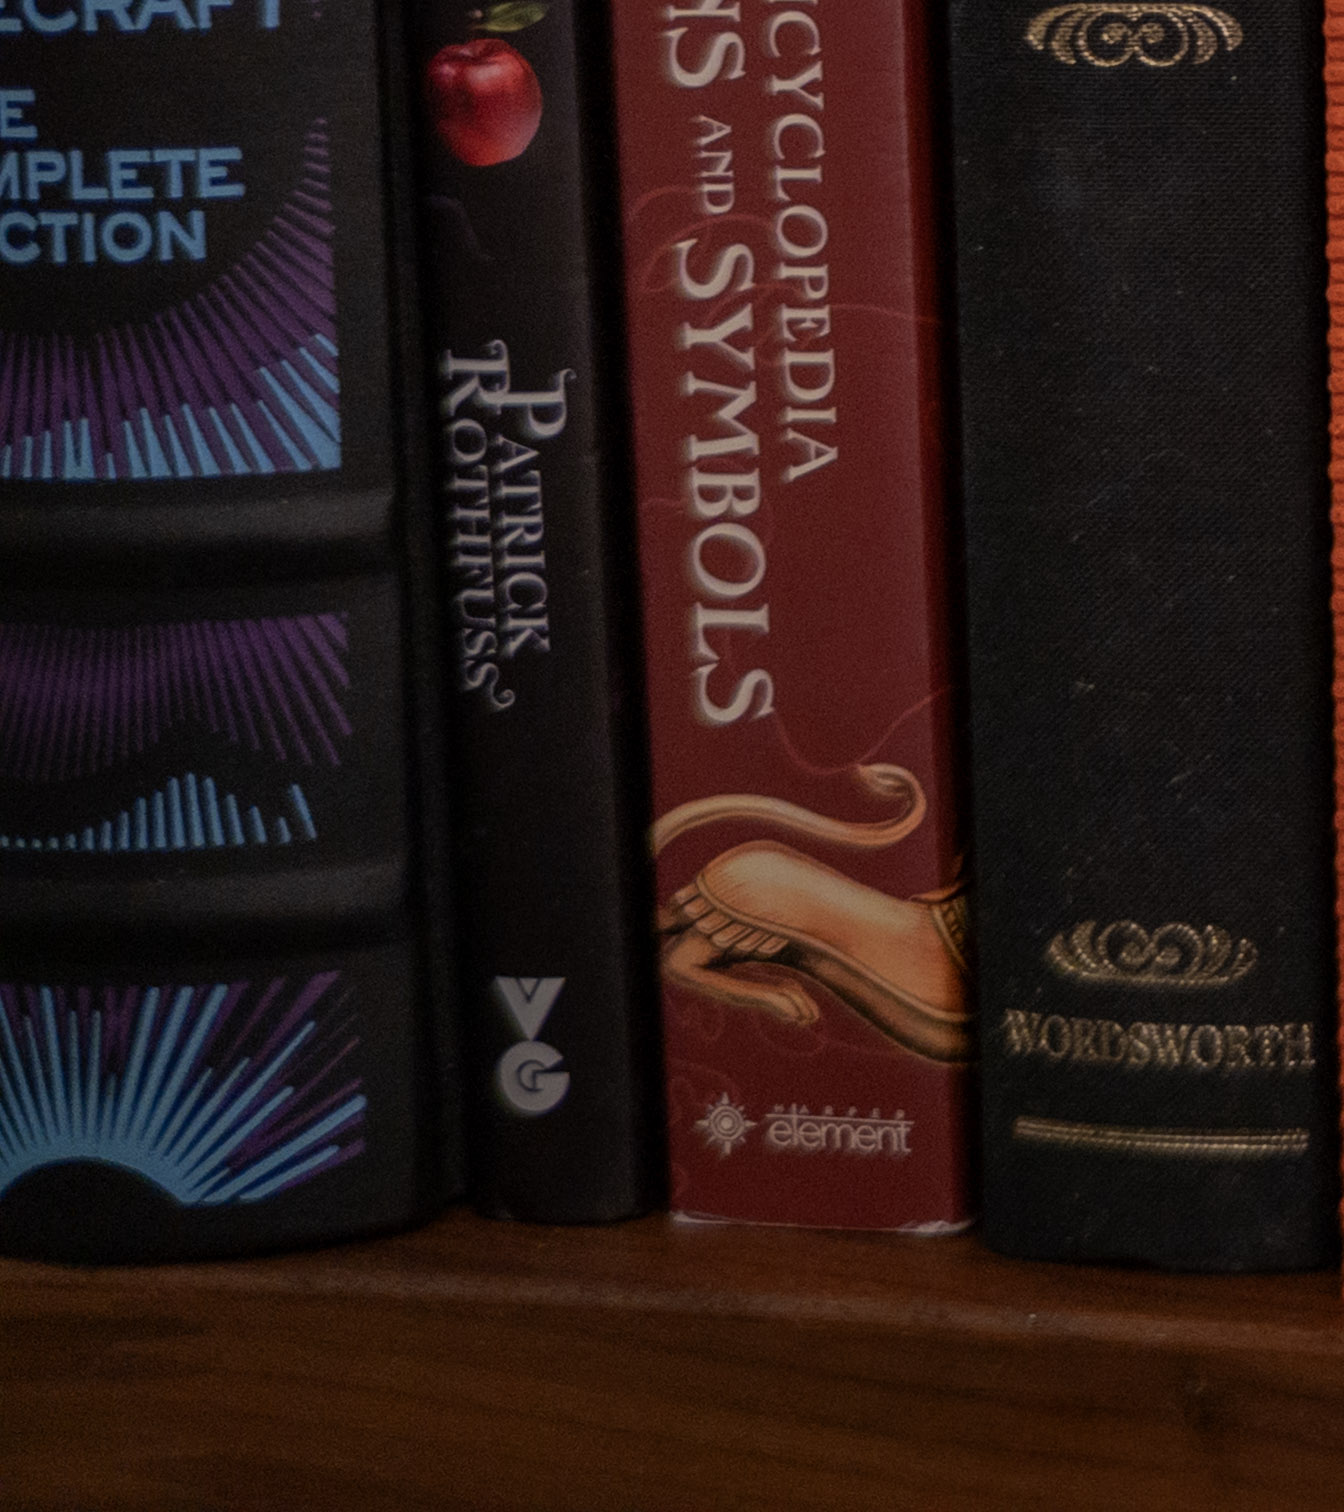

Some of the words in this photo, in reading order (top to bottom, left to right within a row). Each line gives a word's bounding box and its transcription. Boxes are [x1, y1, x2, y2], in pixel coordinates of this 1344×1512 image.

[696, 115, 737, 217] AND
[0, 210, 206, 264] CTION
[442, 338, 516, 711] ROTHFUSS
[495, 367, 578, 659] PATRICK
[674, 236, 776, 727] SYMBOLS
[1001, 1008, 1317, 1070] WORDSWORTH
[768, 1102, 912, 1153] element
